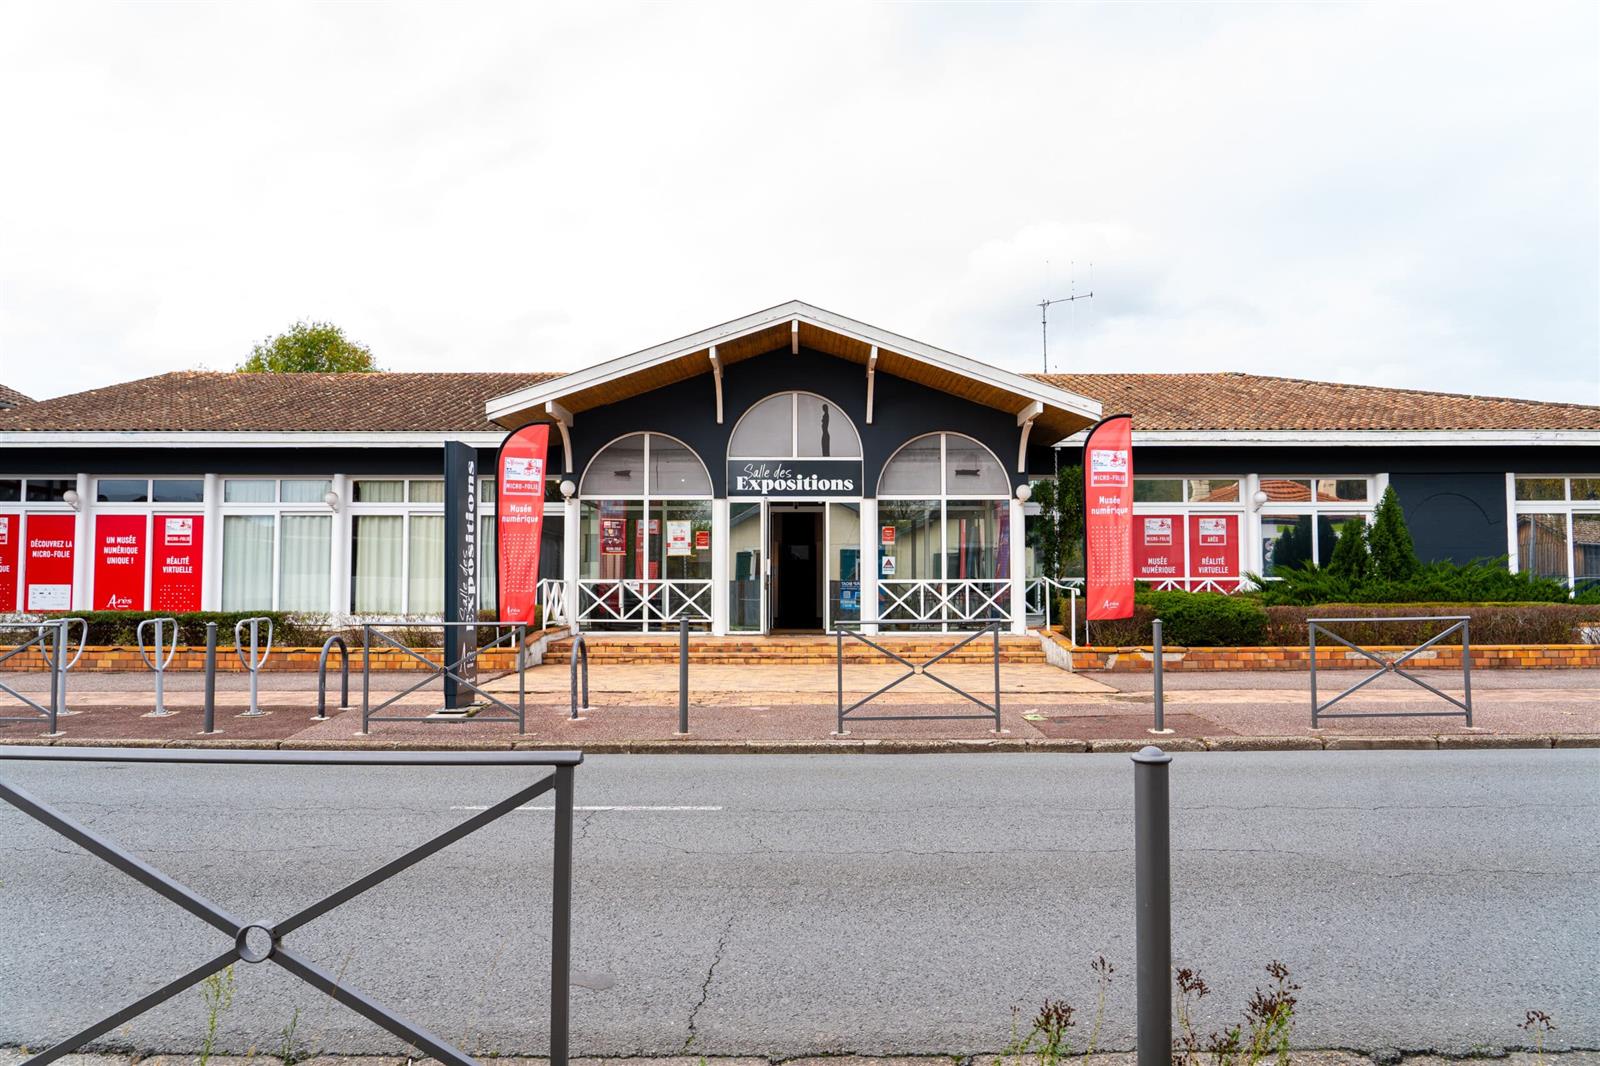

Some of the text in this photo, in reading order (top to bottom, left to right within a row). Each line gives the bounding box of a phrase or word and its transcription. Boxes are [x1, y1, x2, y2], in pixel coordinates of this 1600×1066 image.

[743, 463, 793, 480] Salle des
[1093, 474, 1125, 482] MICRO-FOLIE
[506, 481, 539, 490] MICRO-FOLIE
[736, 474, 854, 495] Expositions
[1098, 496, 1121, 505] Musée
[509, 504, 532, 513] Musée
[1091, 505, 1128, 516] numérique
[502, 514, 538, 524] numérique
[30, 539, 73, 548] DÉCOUVREZ LA
[106, 534, 136, 544] UN MUSÉE
[104, 545, 138, 555] NUMÉRIQUE
[466, 460, 475, 632] Expositions
[32, 550, 71, 558] MICRO-FOLIE
[106, 556, 129, 565] UNIQUE
[166, 556, 190, 565] RÉALITÉ
[1147, 556, 1168, 565] MUSÉE
[1201, 556, 1225, 565] RÉALITÉ
[162, 566, 193, 574] VIRTUELLE
[1142, 565, 1176, 574] NUMÉRIQUE
[1198, 566, 1229, 574] VIRTUELLE
[458, 550, 468, 621] Salle des
